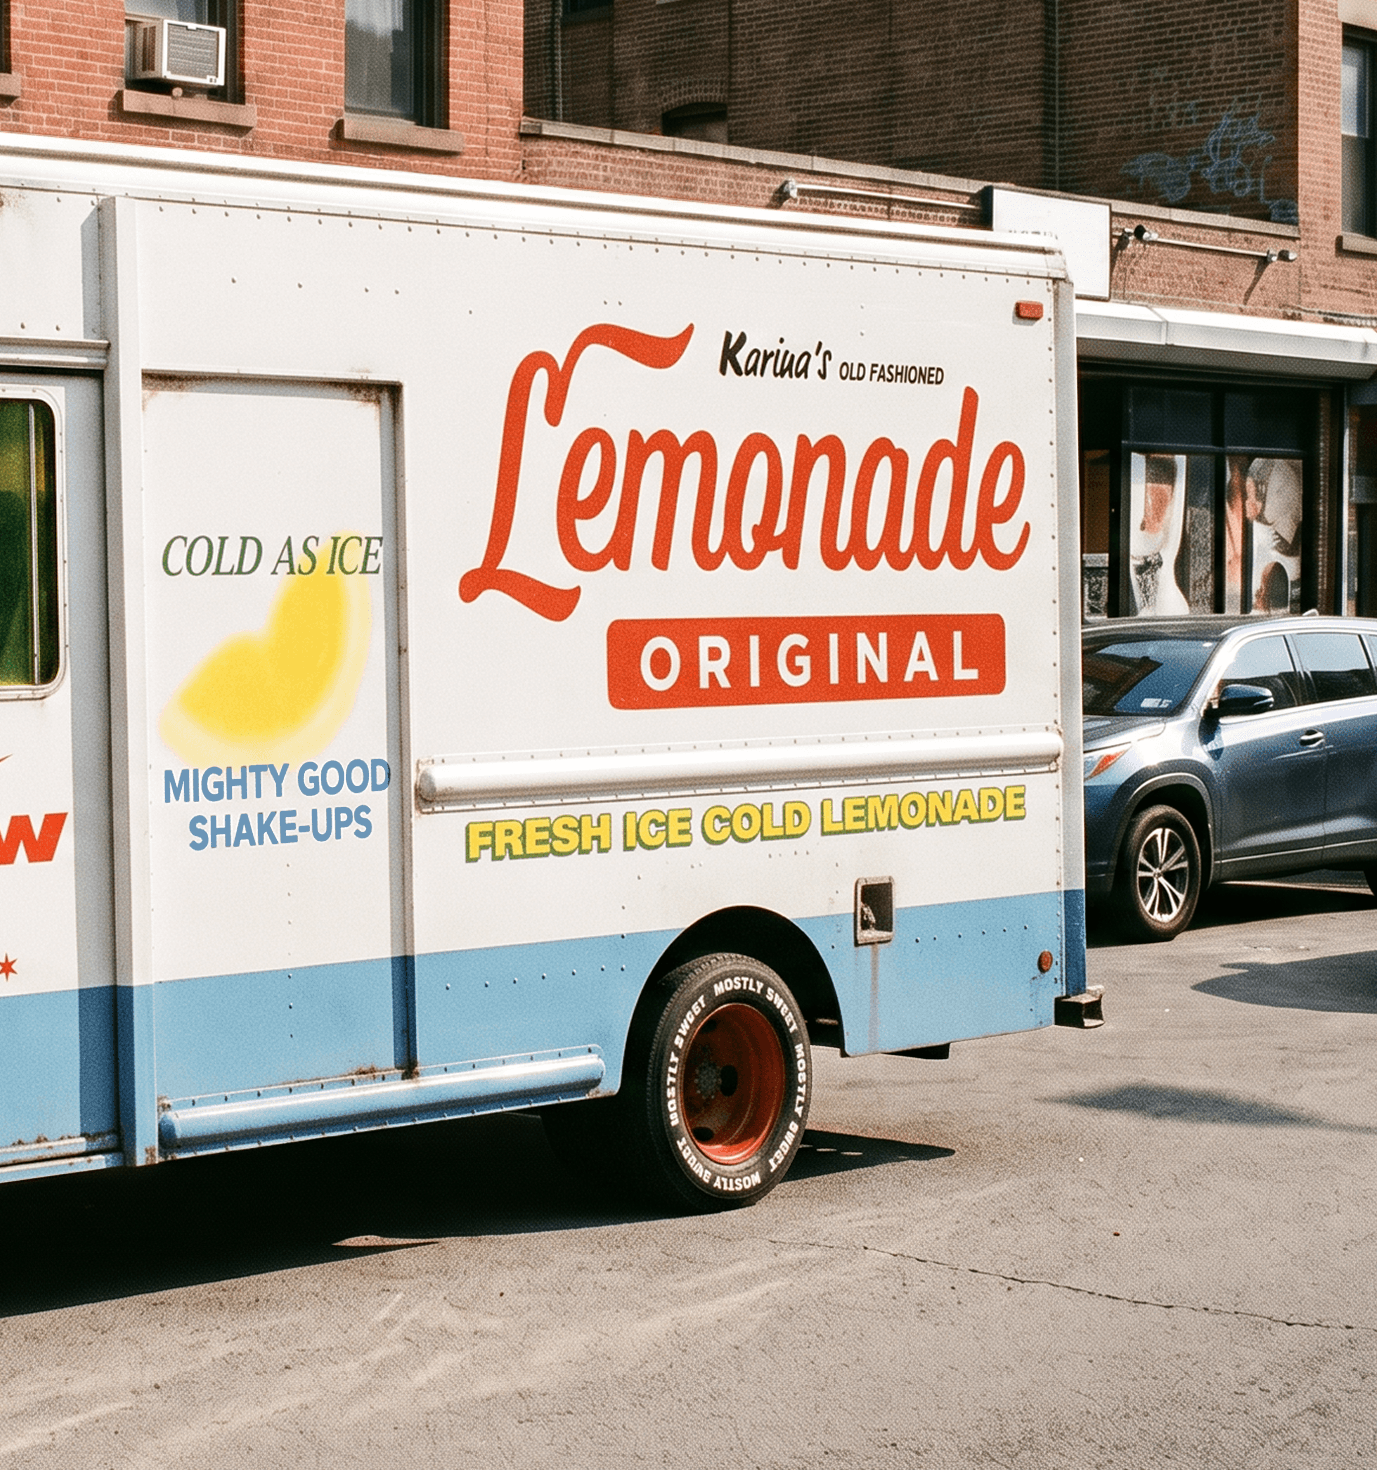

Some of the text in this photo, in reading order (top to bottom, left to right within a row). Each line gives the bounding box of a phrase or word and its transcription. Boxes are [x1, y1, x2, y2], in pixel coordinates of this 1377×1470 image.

[838, 361, 866, 381] OLD
[869, 363, 945, 385] FASHIONED
[458, 322, 1031, 623] Lemonade
[161, 535, 384, 577] COLD AS ICE
[639, 630, 979, 692] ORIGINAL
[164, 758, 392, 804] MIGHTY GOOD
[188, 804, 373, 851] SHAKE-UPS
[464, 784, 1026, 864] FRESH ICE COLD LEMONADE
[713, 976, 799, 1034] MOSTLY SWEET
[794, 1043, 807, 1118] MOSTLY
[713, 1171, 761, 1191] MOSTLY
